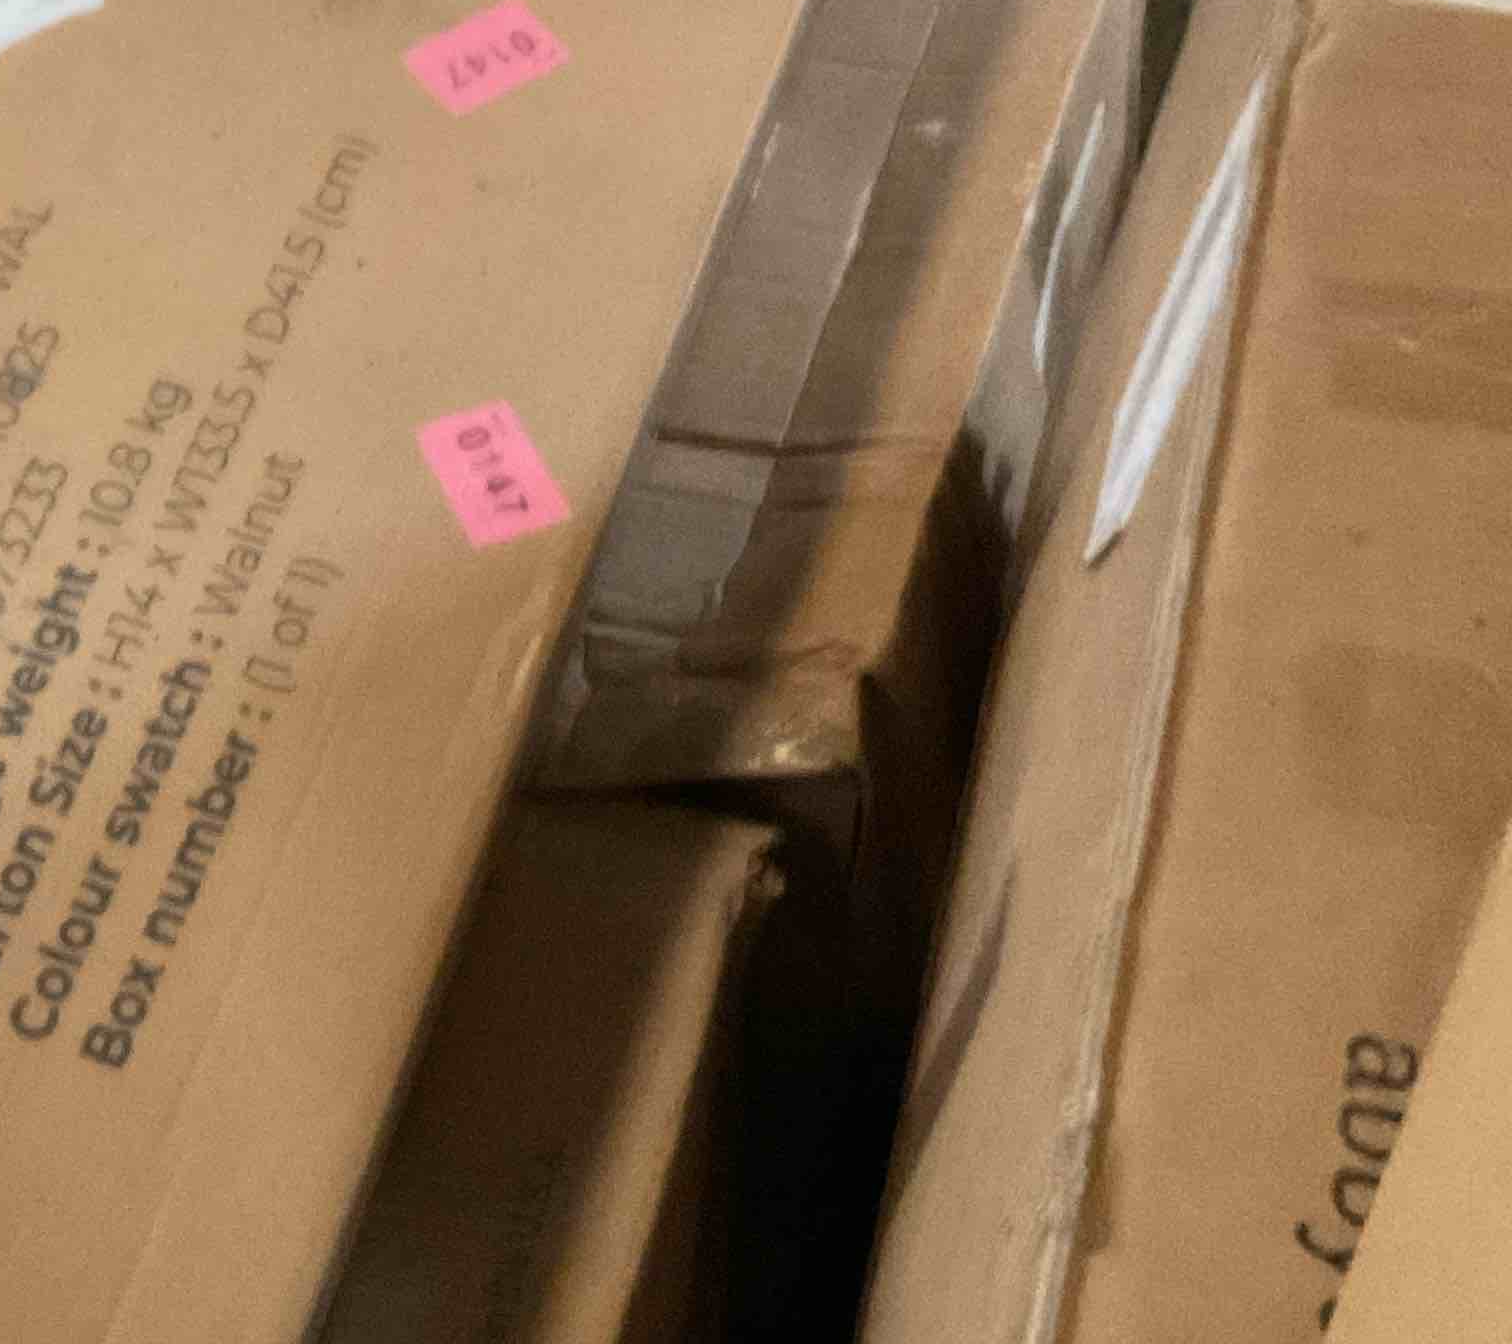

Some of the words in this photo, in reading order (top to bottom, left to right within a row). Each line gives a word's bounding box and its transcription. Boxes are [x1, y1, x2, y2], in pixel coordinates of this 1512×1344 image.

[23, 704, 110, 813] Size
[94, 582, 167, 668] H14
[149, 544, 181, 578] x
[299, 135, 378, 227] (cm)
[81, 442, 155, 529] 10.8
[126, 379, 194, 436] kg
[7, 853, 125, 1042] Colour
[95, 656, 213, 844] swatch
[194, 450, 305, 622] Walnut
[80, 956, 163, 1068] Box
[133, 729, 262, 947] number
[262, 595, 319, 647] of
